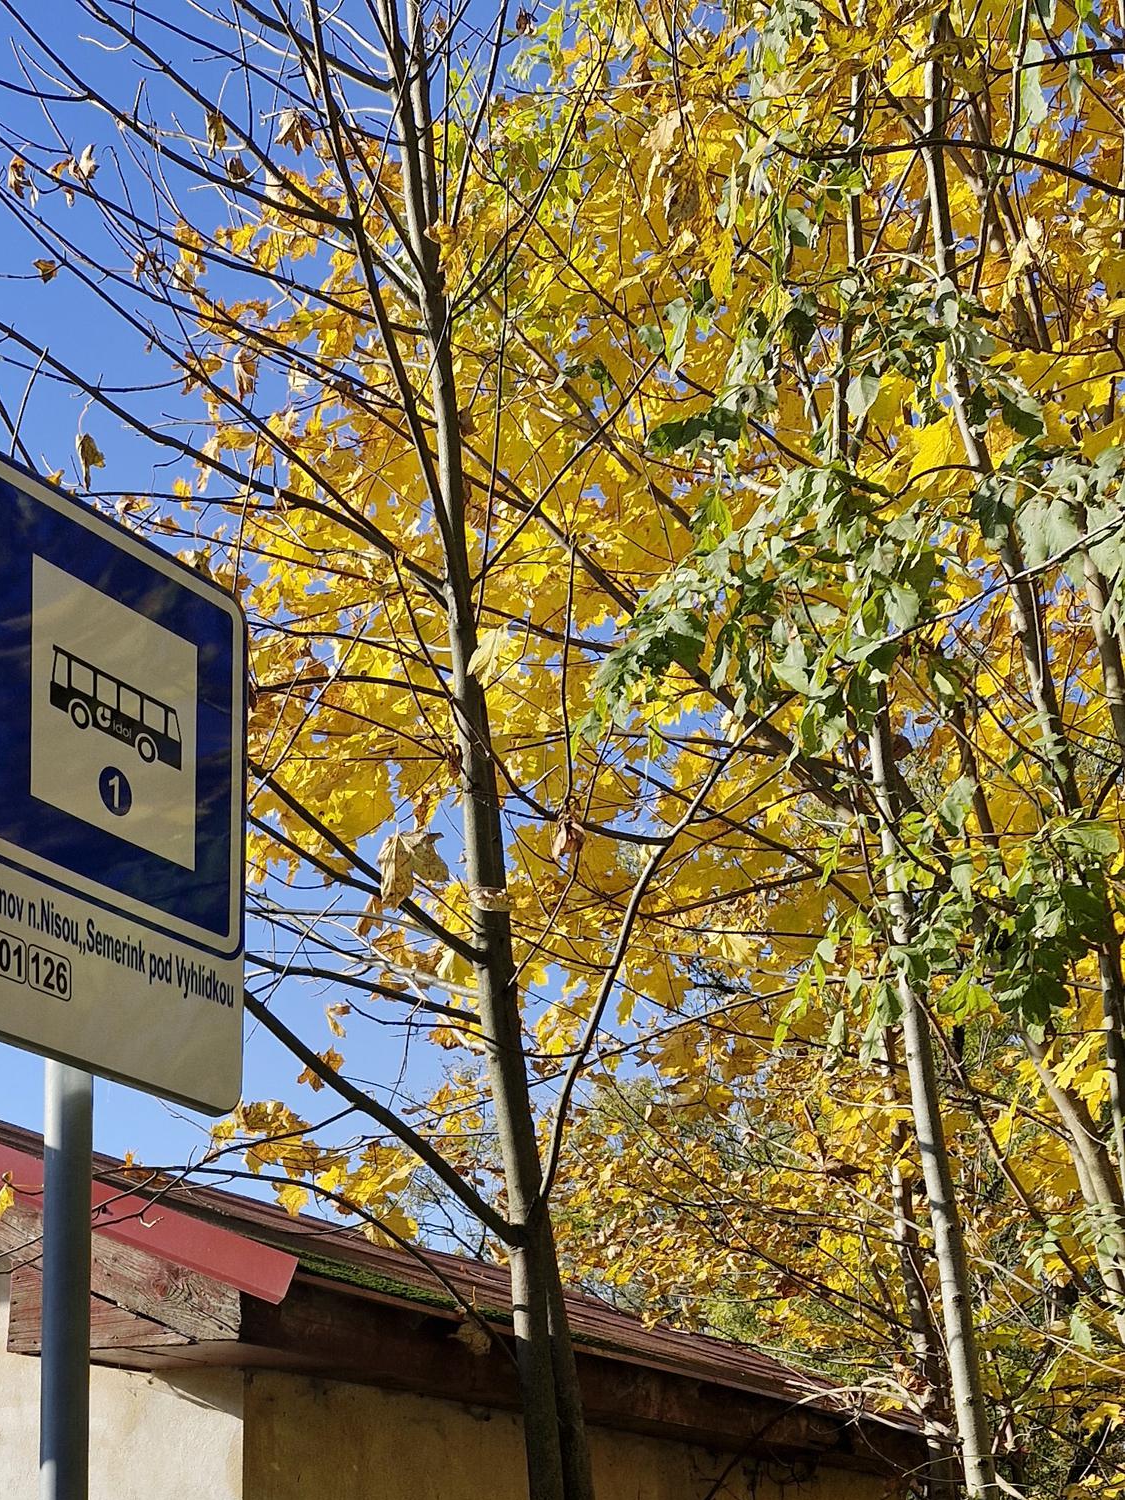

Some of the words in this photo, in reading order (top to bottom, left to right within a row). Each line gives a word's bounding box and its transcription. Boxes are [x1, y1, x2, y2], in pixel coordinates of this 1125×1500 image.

[108, 775, 120, 809] 1
[31, 952, 67, 994] 126
[149, 952, 172, 985] pod
[176, 955, 234, 1008] Vyhlídkou
